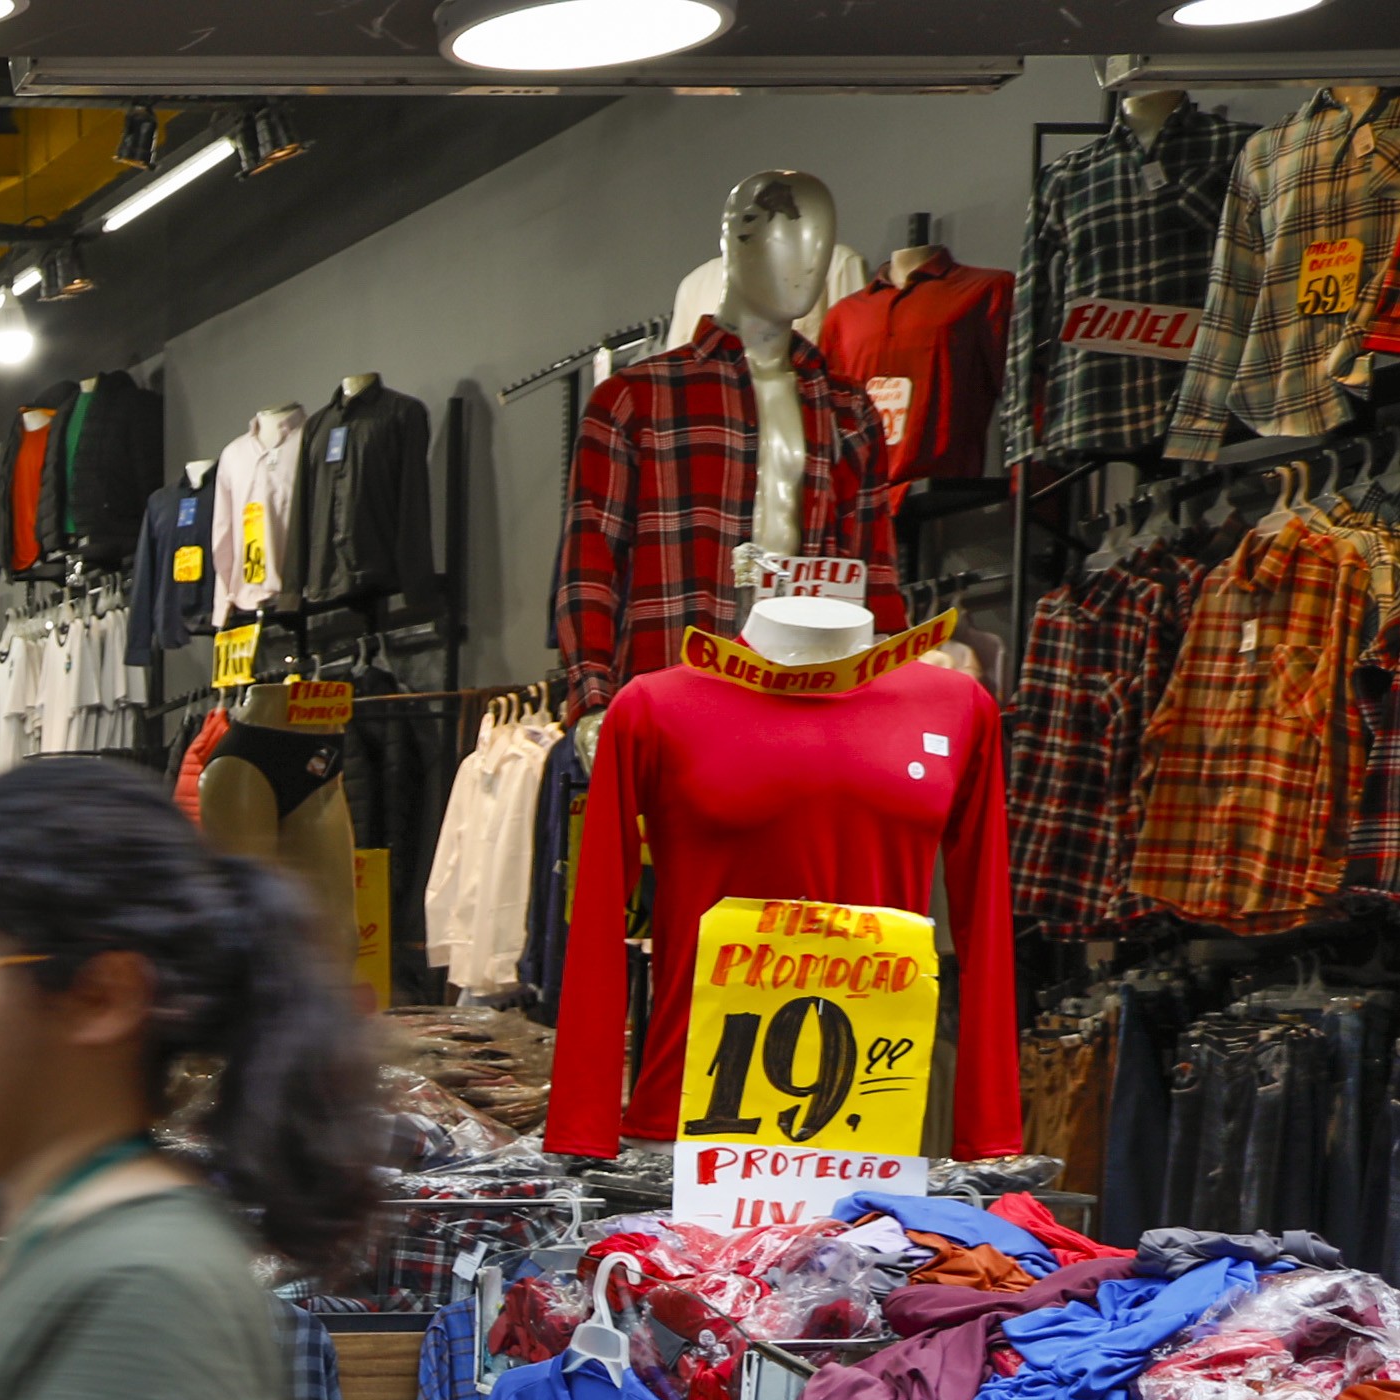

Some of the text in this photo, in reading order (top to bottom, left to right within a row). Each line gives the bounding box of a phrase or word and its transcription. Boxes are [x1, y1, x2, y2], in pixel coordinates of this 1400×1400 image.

[686, 620, 948, 690] QUEIMA TOTAL
[757, 900, 883, 944] MEGA
[710, 943, 918, 998] PROMOÇÃO
[732, 1197, 806, 1229] UV
